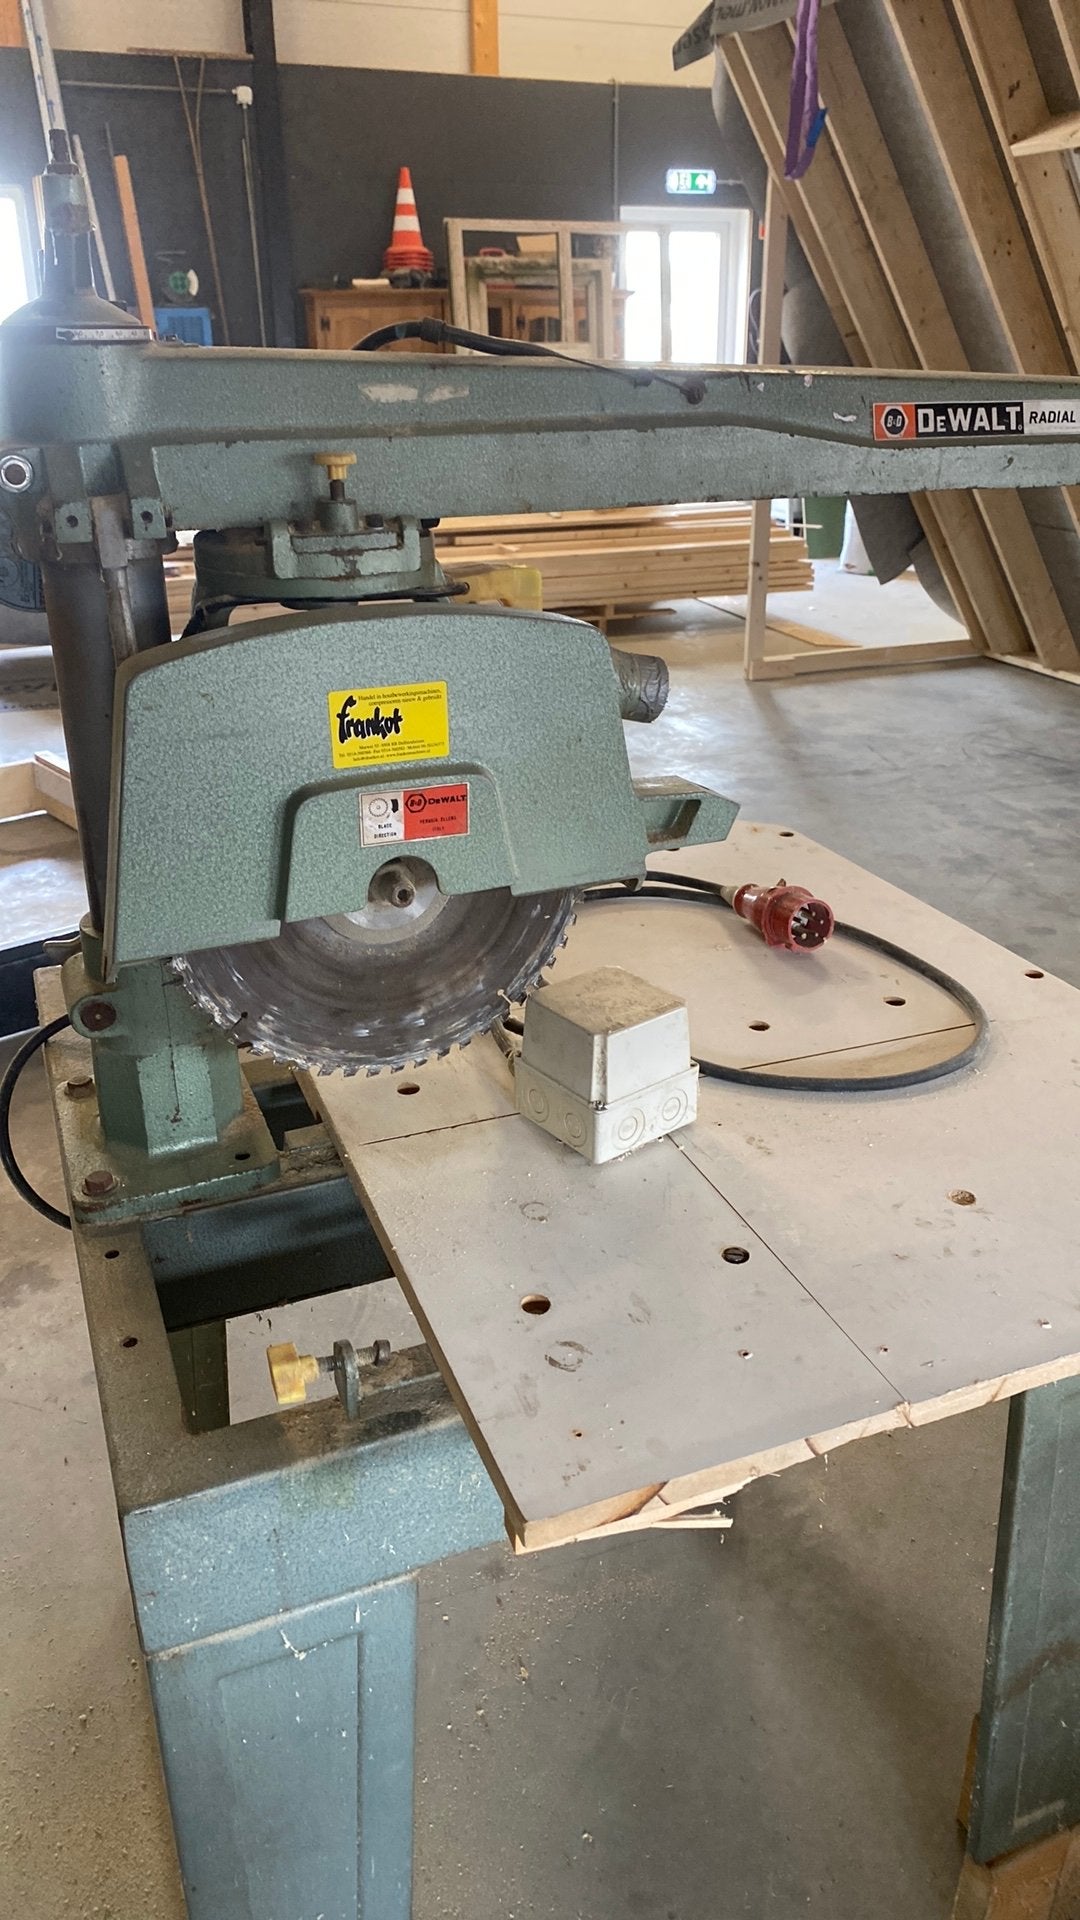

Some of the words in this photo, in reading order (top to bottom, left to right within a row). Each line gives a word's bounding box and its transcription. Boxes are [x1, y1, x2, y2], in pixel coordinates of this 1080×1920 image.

[1029, 410, 1077, 425] RADIAL
[378, 822, 393, 830] BLADE
[373, 831, 397, 840] DIRECTION
